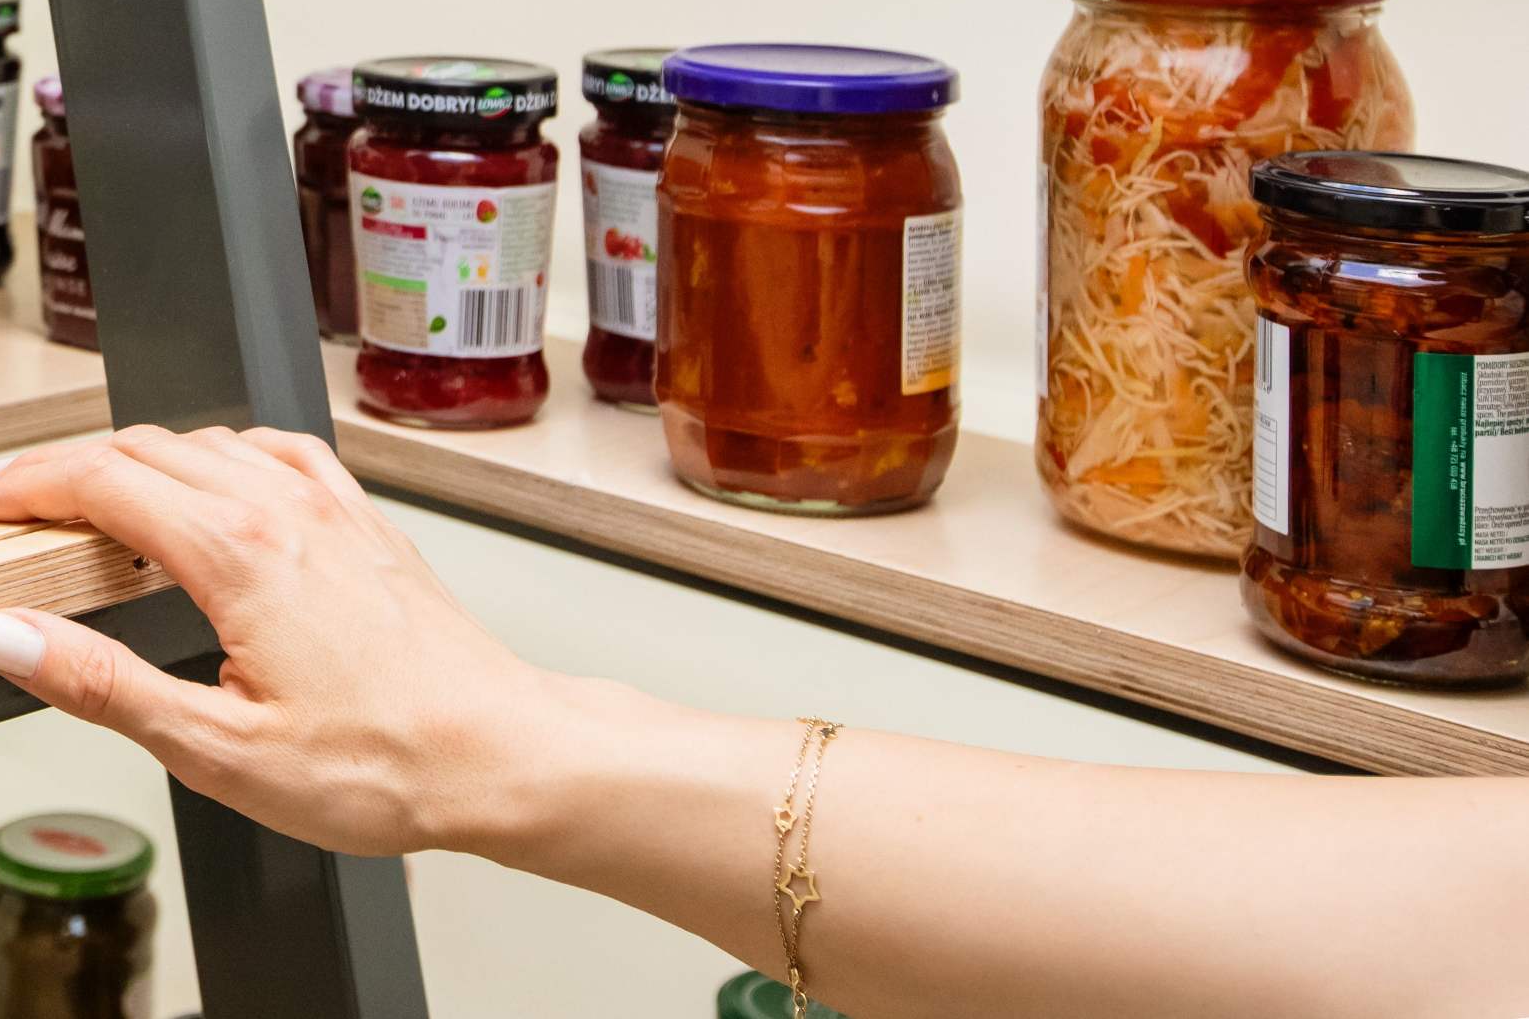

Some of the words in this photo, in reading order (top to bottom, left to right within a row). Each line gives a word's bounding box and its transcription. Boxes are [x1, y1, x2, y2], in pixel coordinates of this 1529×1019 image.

[368, 85, 405, 109] DŻEM
[407, 92, 475, 114] DOBRY!
[515, 91, 551, 113] DŻEM
